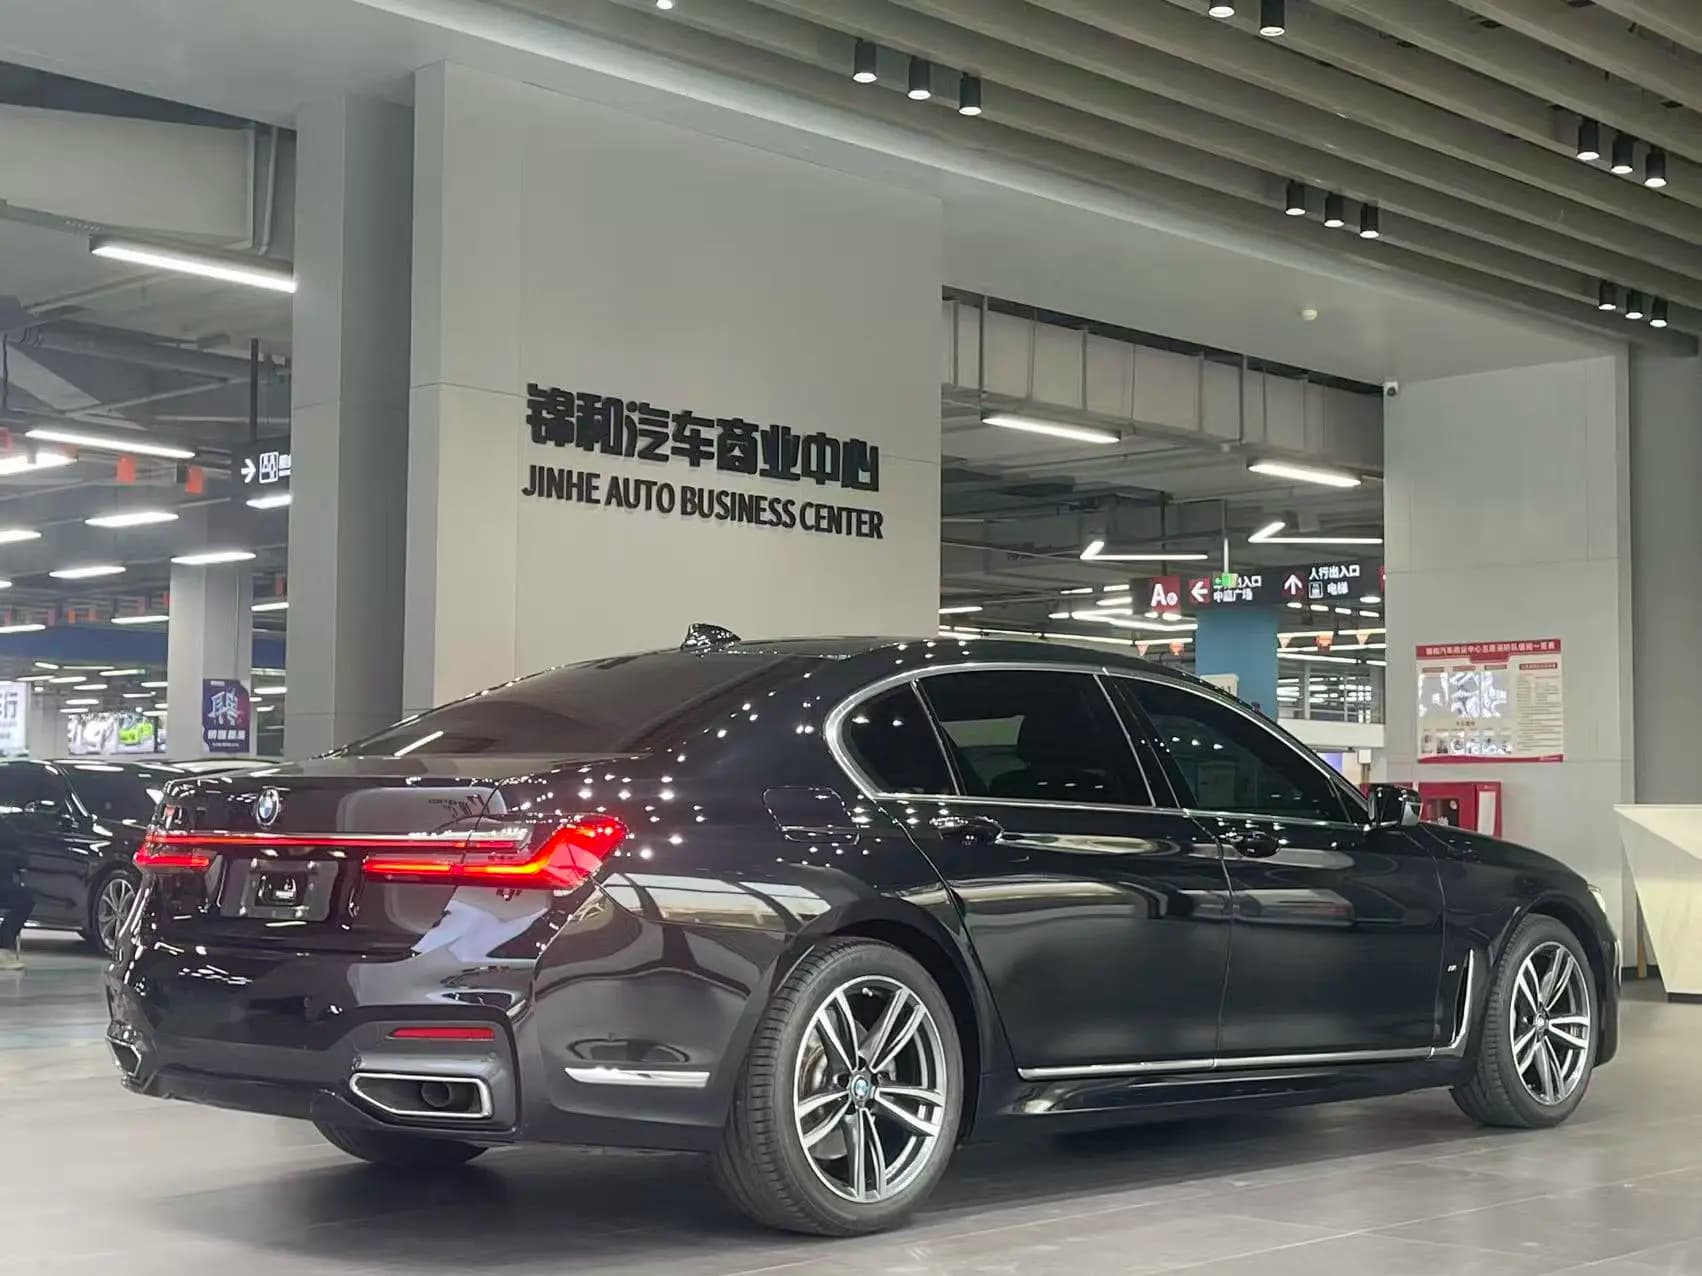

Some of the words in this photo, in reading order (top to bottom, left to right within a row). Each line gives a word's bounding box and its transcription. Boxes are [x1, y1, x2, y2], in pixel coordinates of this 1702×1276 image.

[526, 383, 879, 492] 锦和汽车商业中心
[521, 465, 601, 504] JINHE
[604, 476, 676, 514] AUTO
[680, 485, 797, 528] BUSINESS
[800, 502, 884, 539] CENTER
[1309, 565, 1361, 580] 人行出入口
